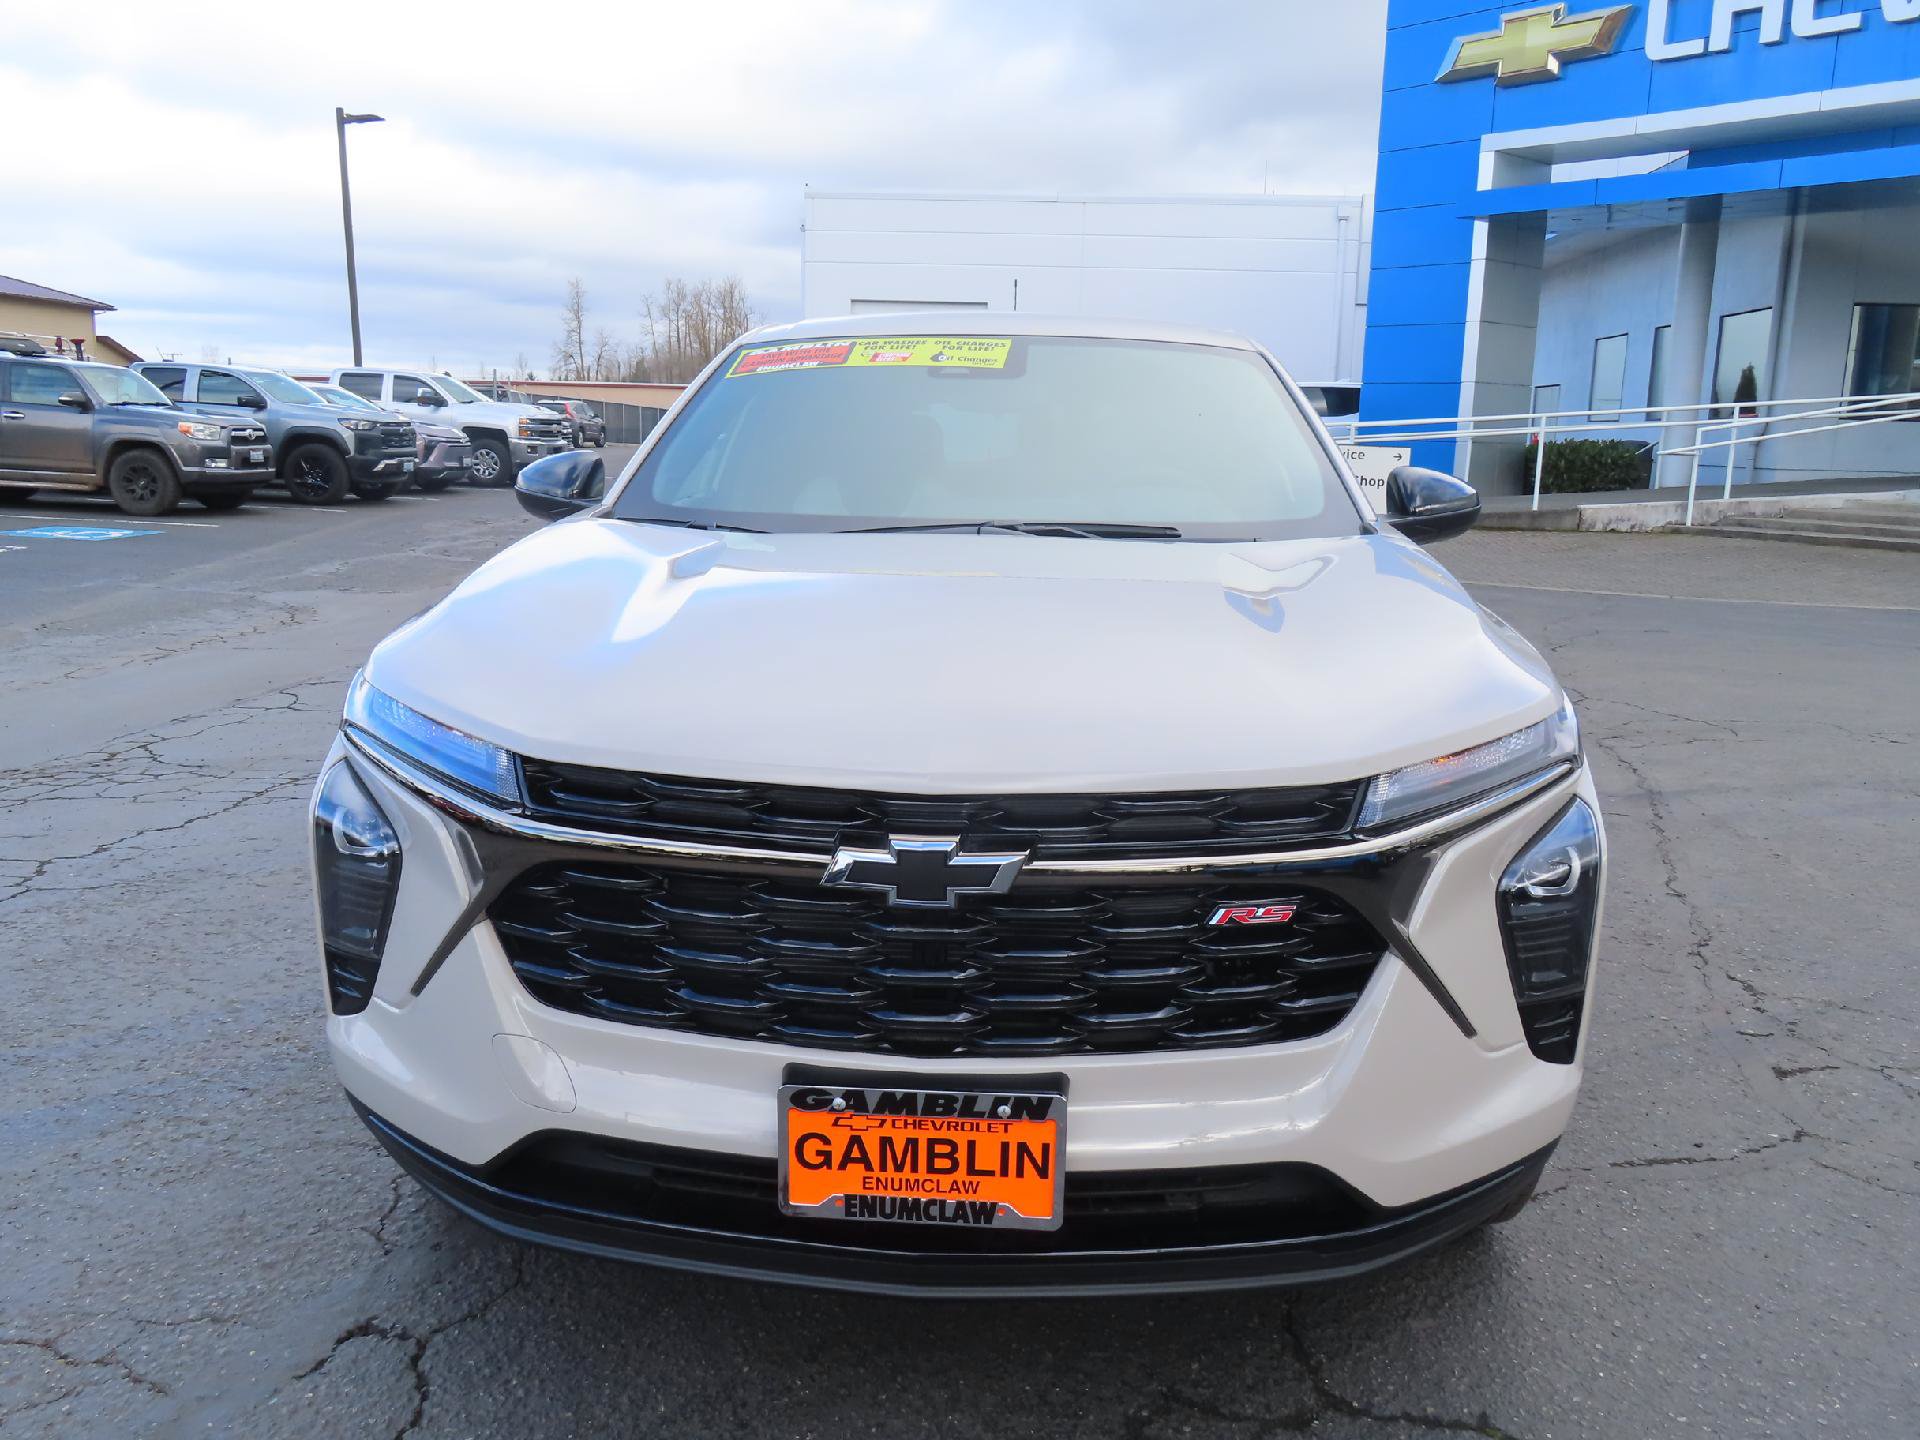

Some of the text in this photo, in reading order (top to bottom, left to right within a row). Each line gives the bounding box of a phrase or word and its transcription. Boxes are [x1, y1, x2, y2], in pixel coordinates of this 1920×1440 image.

[1342, 449, 1366, 460] ice
[1355, 475, 1385, 489] hop
[1208, 905, 1297, 925] RS
[789, 1087, 1054, 1122] GAMBLIN
[891, 1118, 1013, 1134] CHEVROLET
[794, 1131, 1051, 1180] GAMBLIN
[862, 1176, 981, 1195] ENUMCLAW
[844, 1193, 998, 1225] ENUMCLAW
